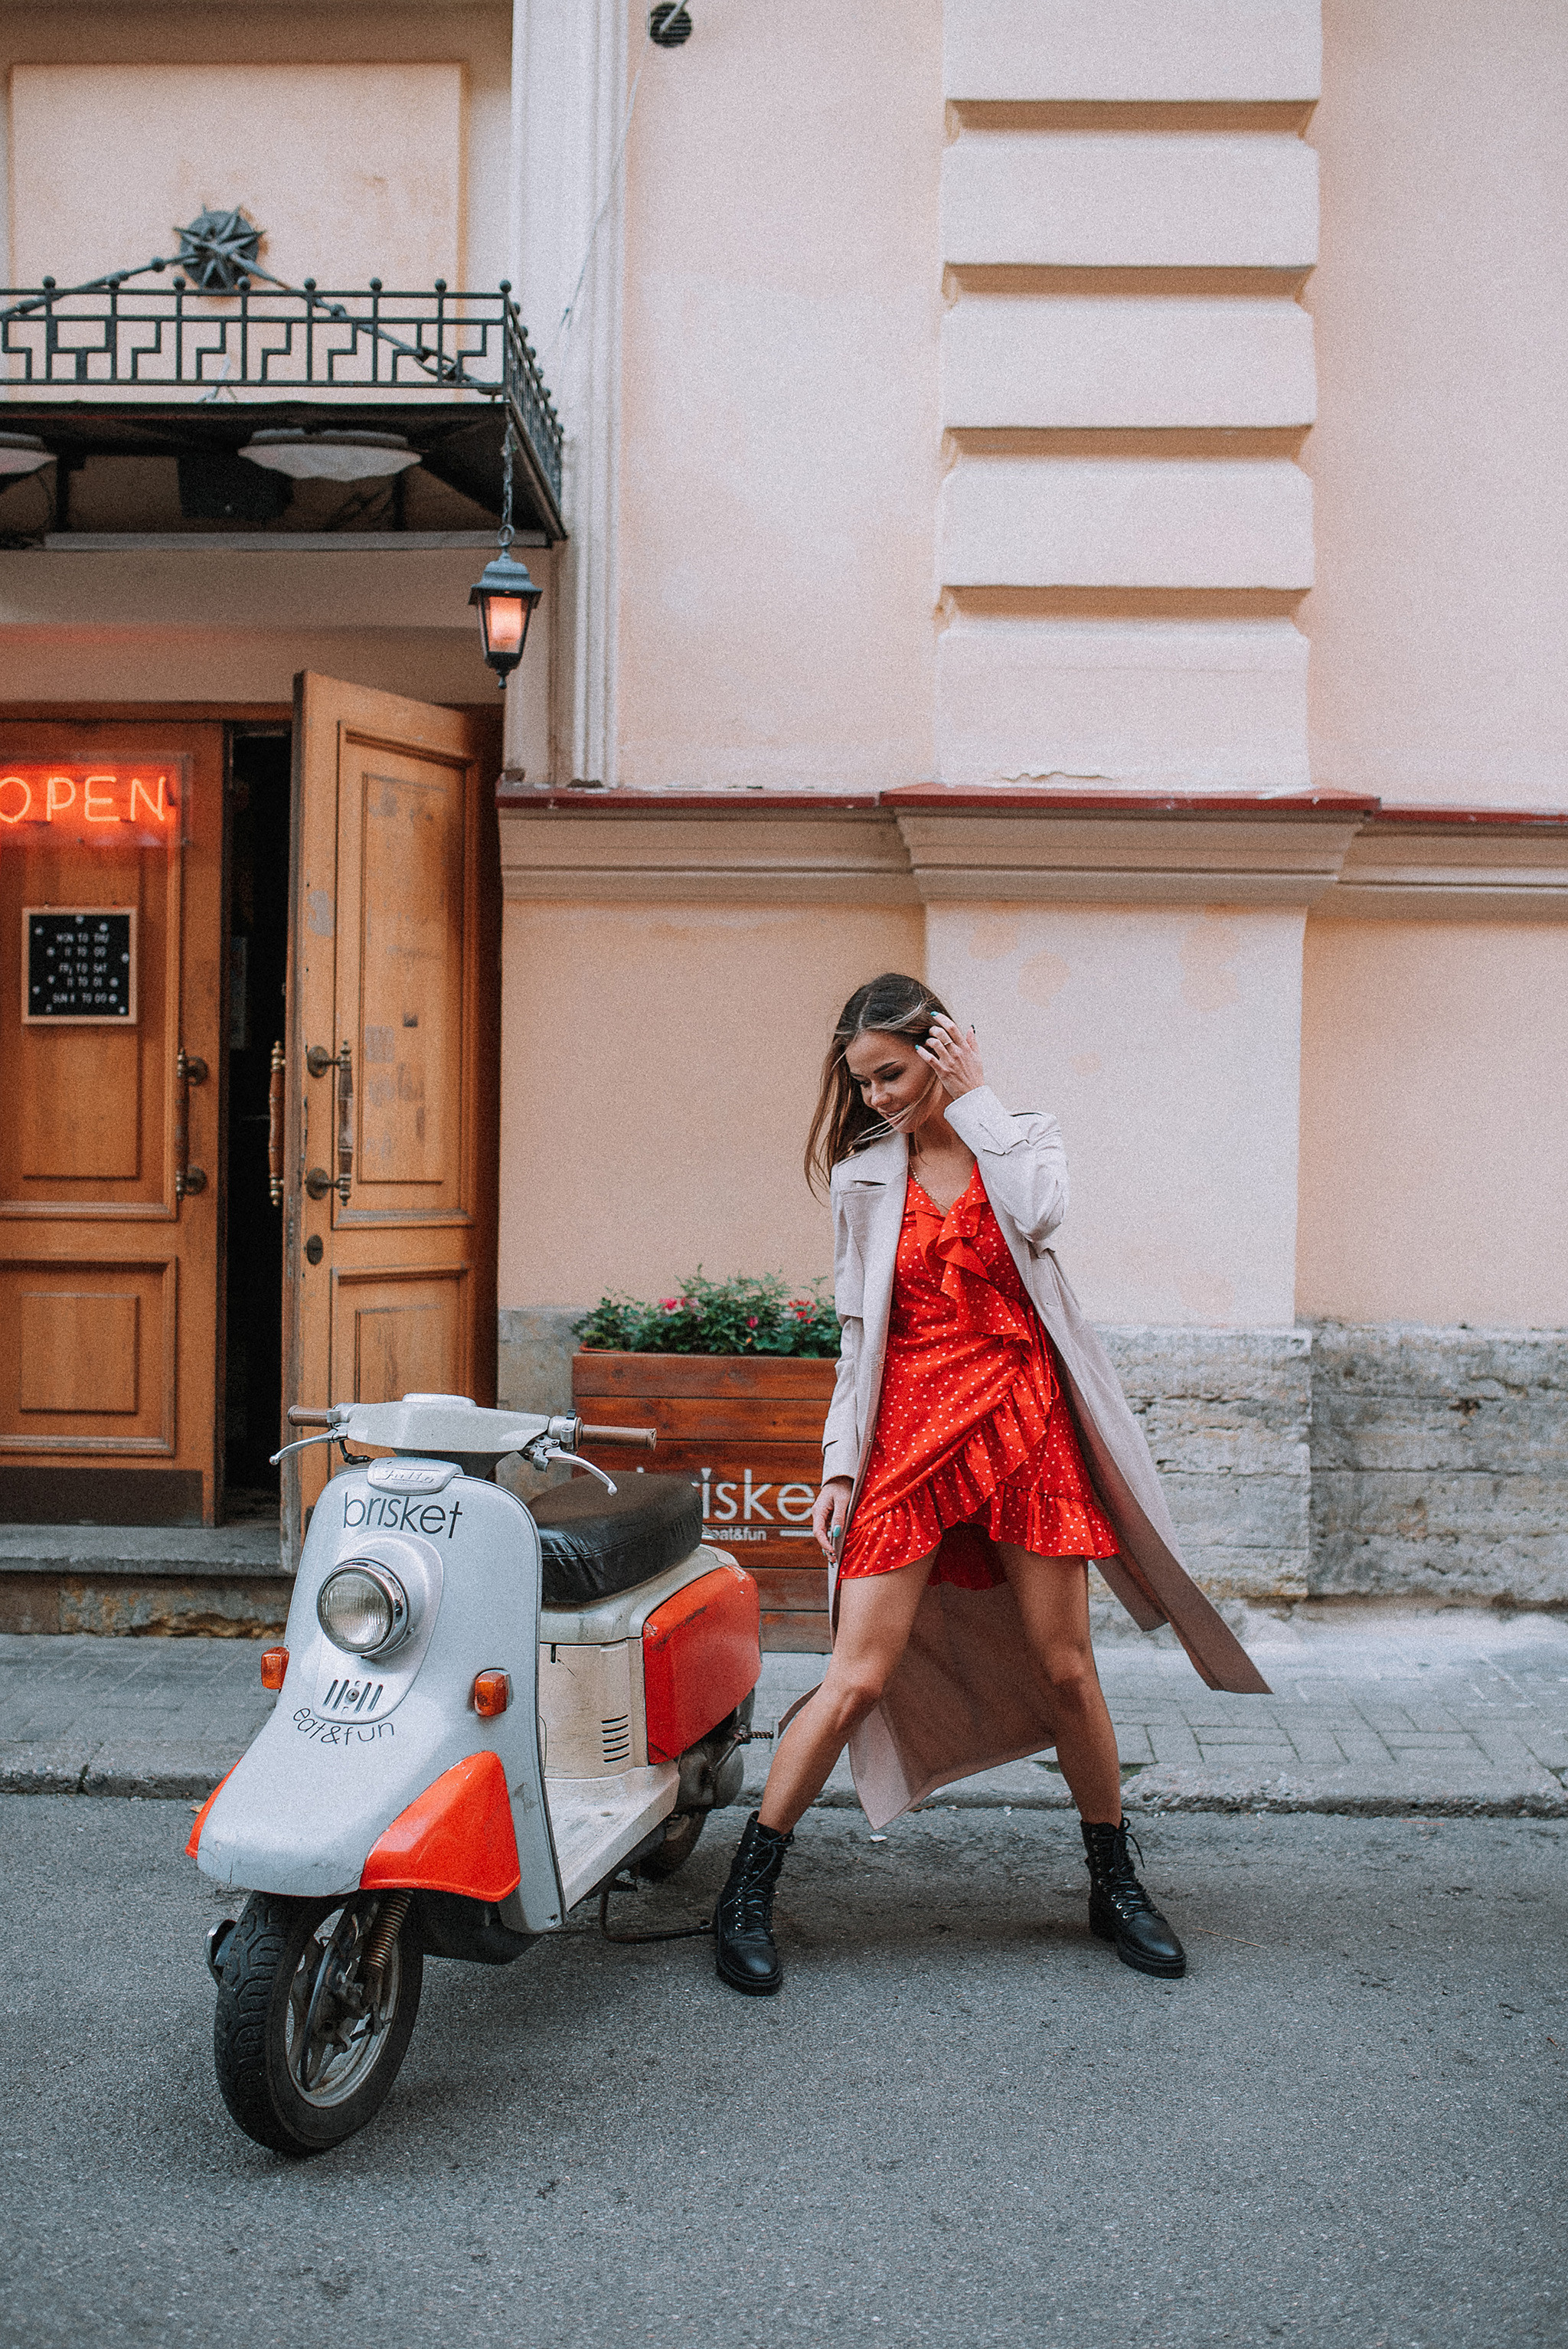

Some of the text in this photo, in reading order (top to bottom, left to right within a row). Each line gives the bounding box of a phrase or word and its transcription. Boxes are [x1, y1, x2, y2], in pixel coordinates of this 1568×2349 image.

[0, 775, 166, 823] OPEN
[343, 1491, 463, 1538] brisket
[292, 1707, 395, 1746] eat&fun
